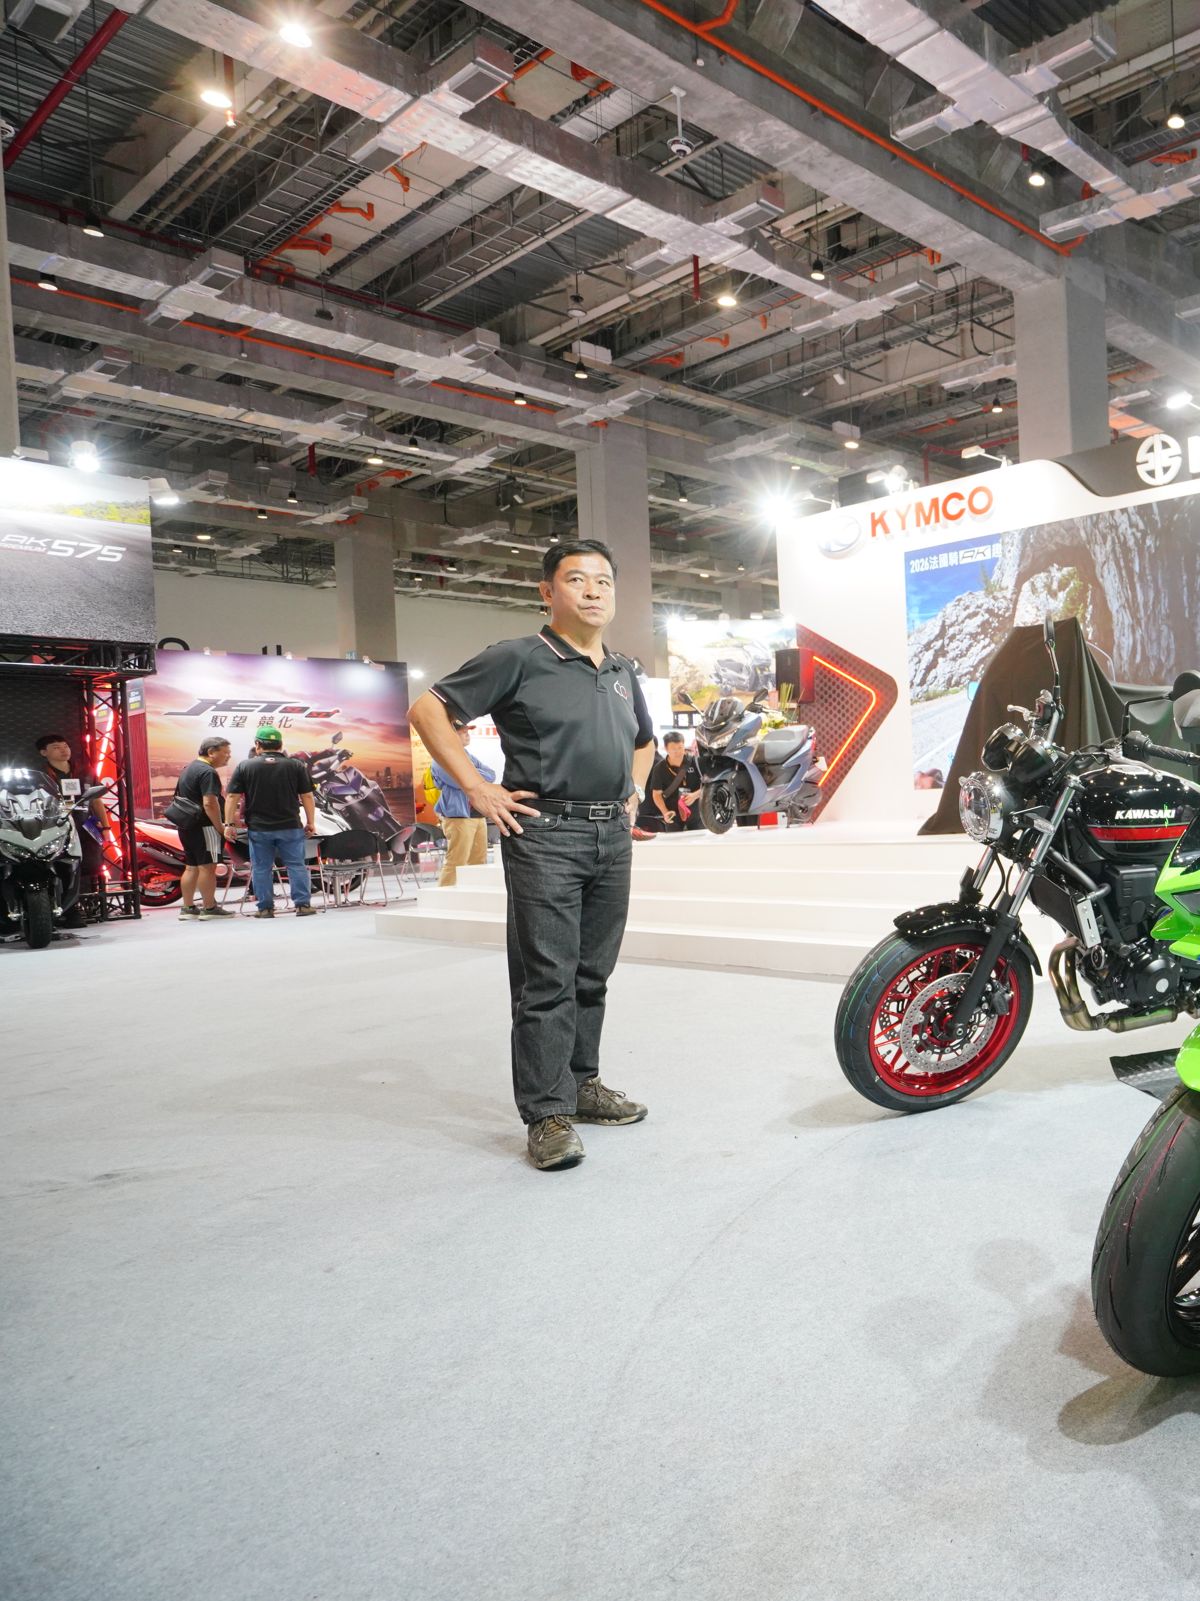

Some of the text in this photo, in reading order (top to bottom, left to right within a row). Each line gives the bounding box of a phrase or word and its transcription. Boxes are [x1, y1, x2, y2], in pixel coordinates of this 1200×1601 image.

[870, 486, 993, 538] KYMCO
[47, 539, 127, 562] 575
[1114, 809, 1176, 820] KAWASAKI
